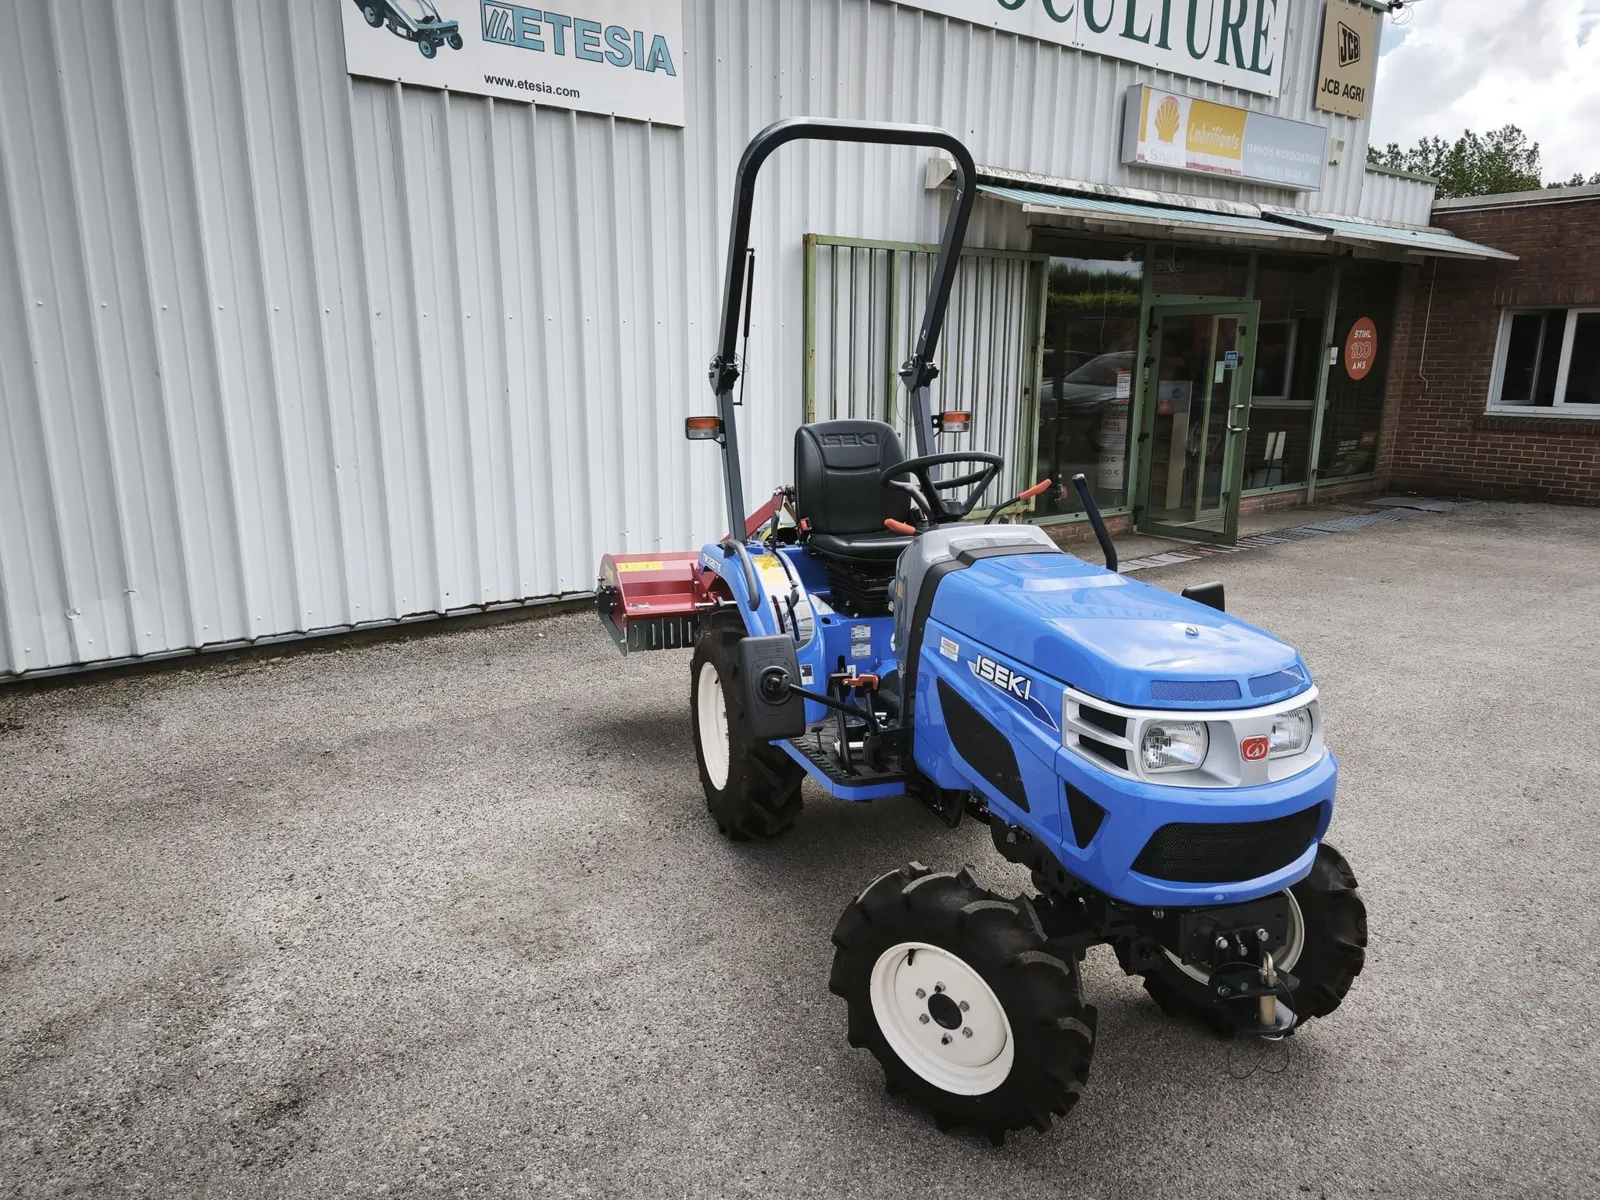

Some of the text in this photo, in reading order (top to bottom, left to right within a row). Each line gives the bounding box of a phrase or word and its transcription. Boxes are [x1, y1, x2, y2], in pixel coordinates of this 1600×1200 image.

[480, 0, 677, 77] ETESIA
[1340, 27, 1360, 62] JCB
[484, 73, 581, 98] www.etesia.com
[1321, 77, 1365, 102] JCB AGRI
[1189, 122, 1240, 150] Lubrifiants
[1149, 148, 1181, 164] Shell
[1353, 329, 1372, 339] STIHL
[1350, 341, 1372, 360] 100
[1352, 360, 1367, 370] ANS
[820, 432, 879, 447] ISEKI
[974, 654, 1032, 700] ISEKI
